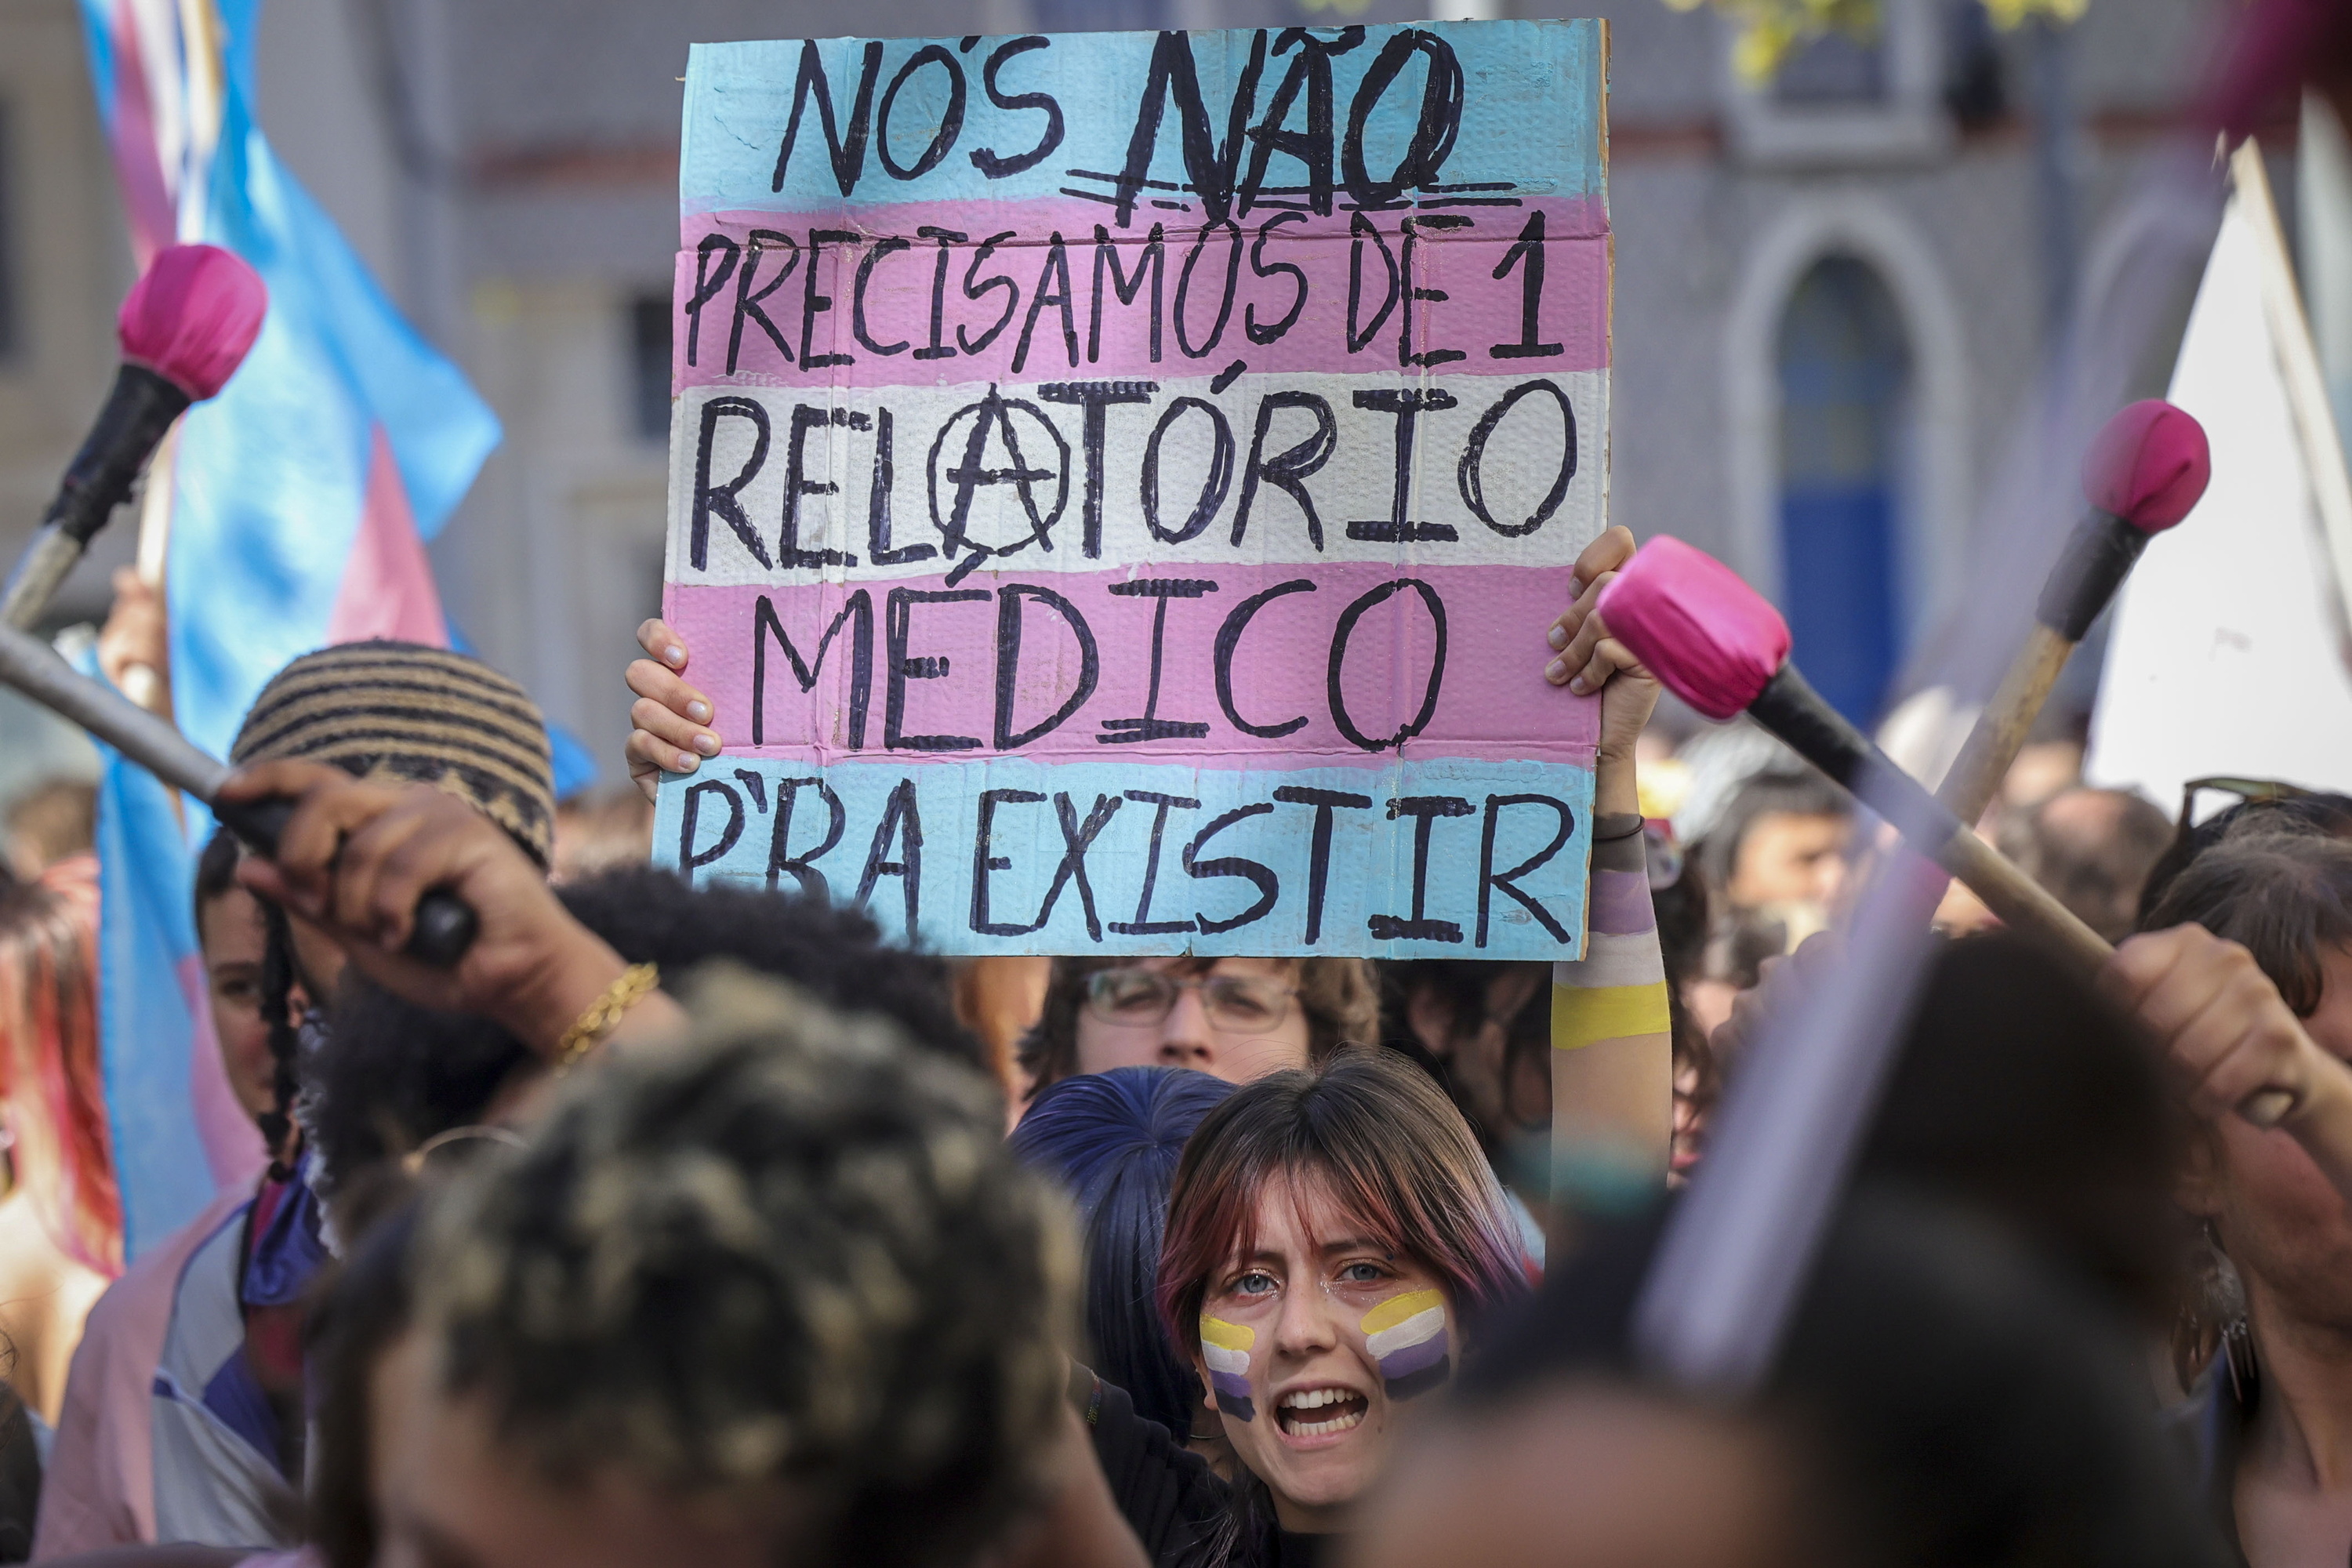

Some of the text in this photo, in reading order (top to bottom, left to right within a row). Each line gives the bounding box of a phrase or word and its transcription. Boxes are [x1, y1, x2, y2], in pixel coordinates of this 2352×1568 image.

[771, 25, 1465, 227] NÓS NÃO
[685, 209, 1563, 376] PRECISAMOS DE 1
[690, 361, 1578, 572] RELATÓRIO
[753, 554, 1447, 752] MÉDICO
[679, 768, 1573, 948] P'RA EXISTIR
